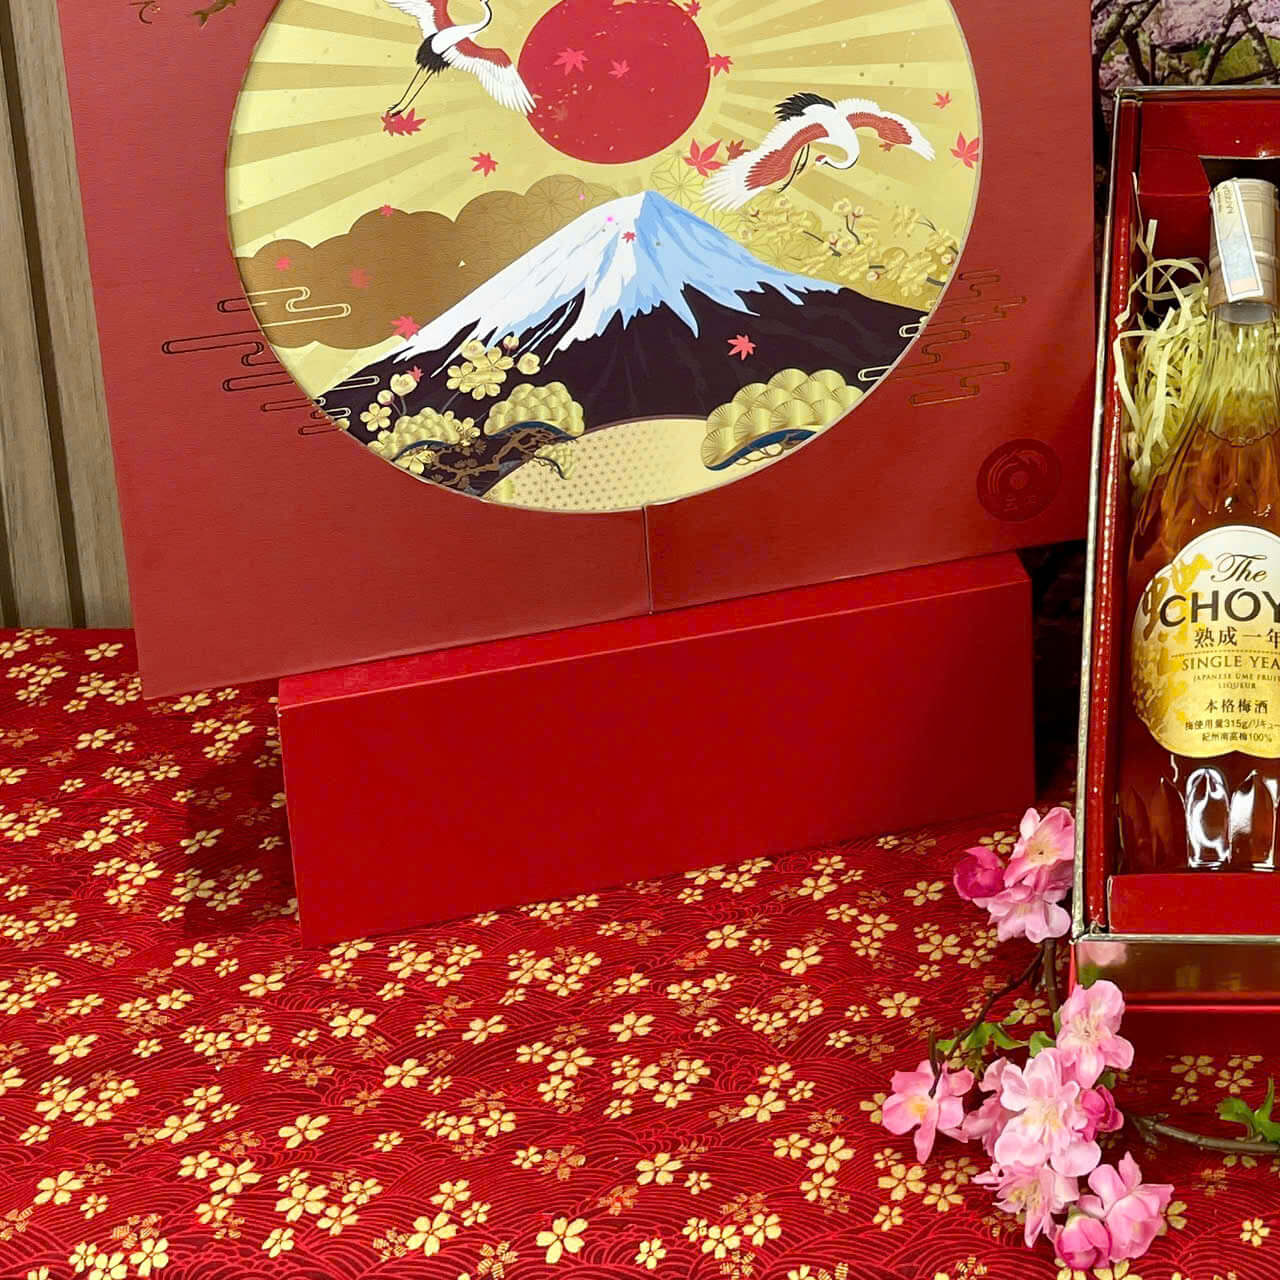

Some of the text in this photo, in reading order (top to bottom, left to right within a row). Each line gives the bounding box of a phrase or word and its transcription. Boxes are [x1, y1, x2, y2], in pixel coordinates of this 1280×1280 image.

[1210, 552, 1268, 582] The
[1181, 655, 1243, 672] SINGLE
[1193, 674, 1232, 682] JAPANESE
[1204, 698, 1269, 714] 本格梅酒
